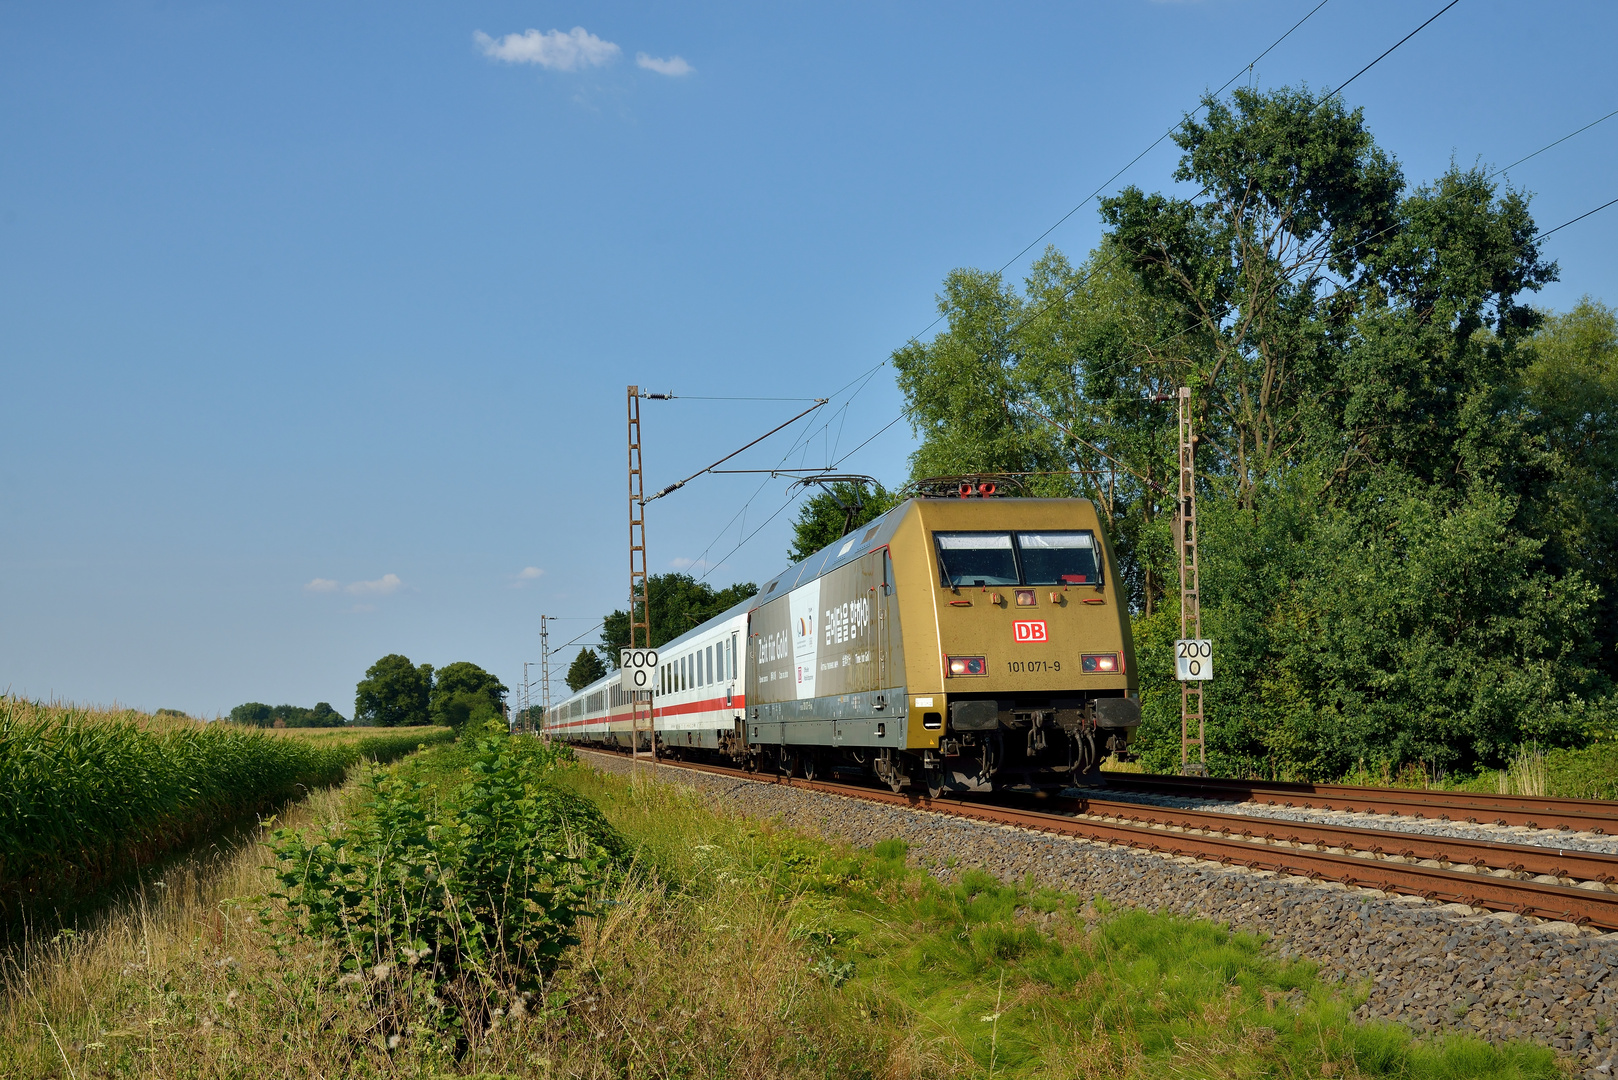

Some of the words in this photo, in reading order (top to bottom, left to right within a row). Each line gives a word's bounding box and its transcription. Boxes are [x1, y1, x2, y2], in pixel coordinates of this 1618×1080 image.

[825, 602, 849, 646] 금메달을
[1017, 623, 1044, 639] DB
[759, 637, 768, 664] Zeit
[768, 633, 776, 662] für
[776, 628, 788, 660] Gold
[1178, 642, 1211, 658] 200
[623, 651, 658, 668] 200
[1189, 660, 1200, 675] 0
[634, 670, 646, 686] 0
